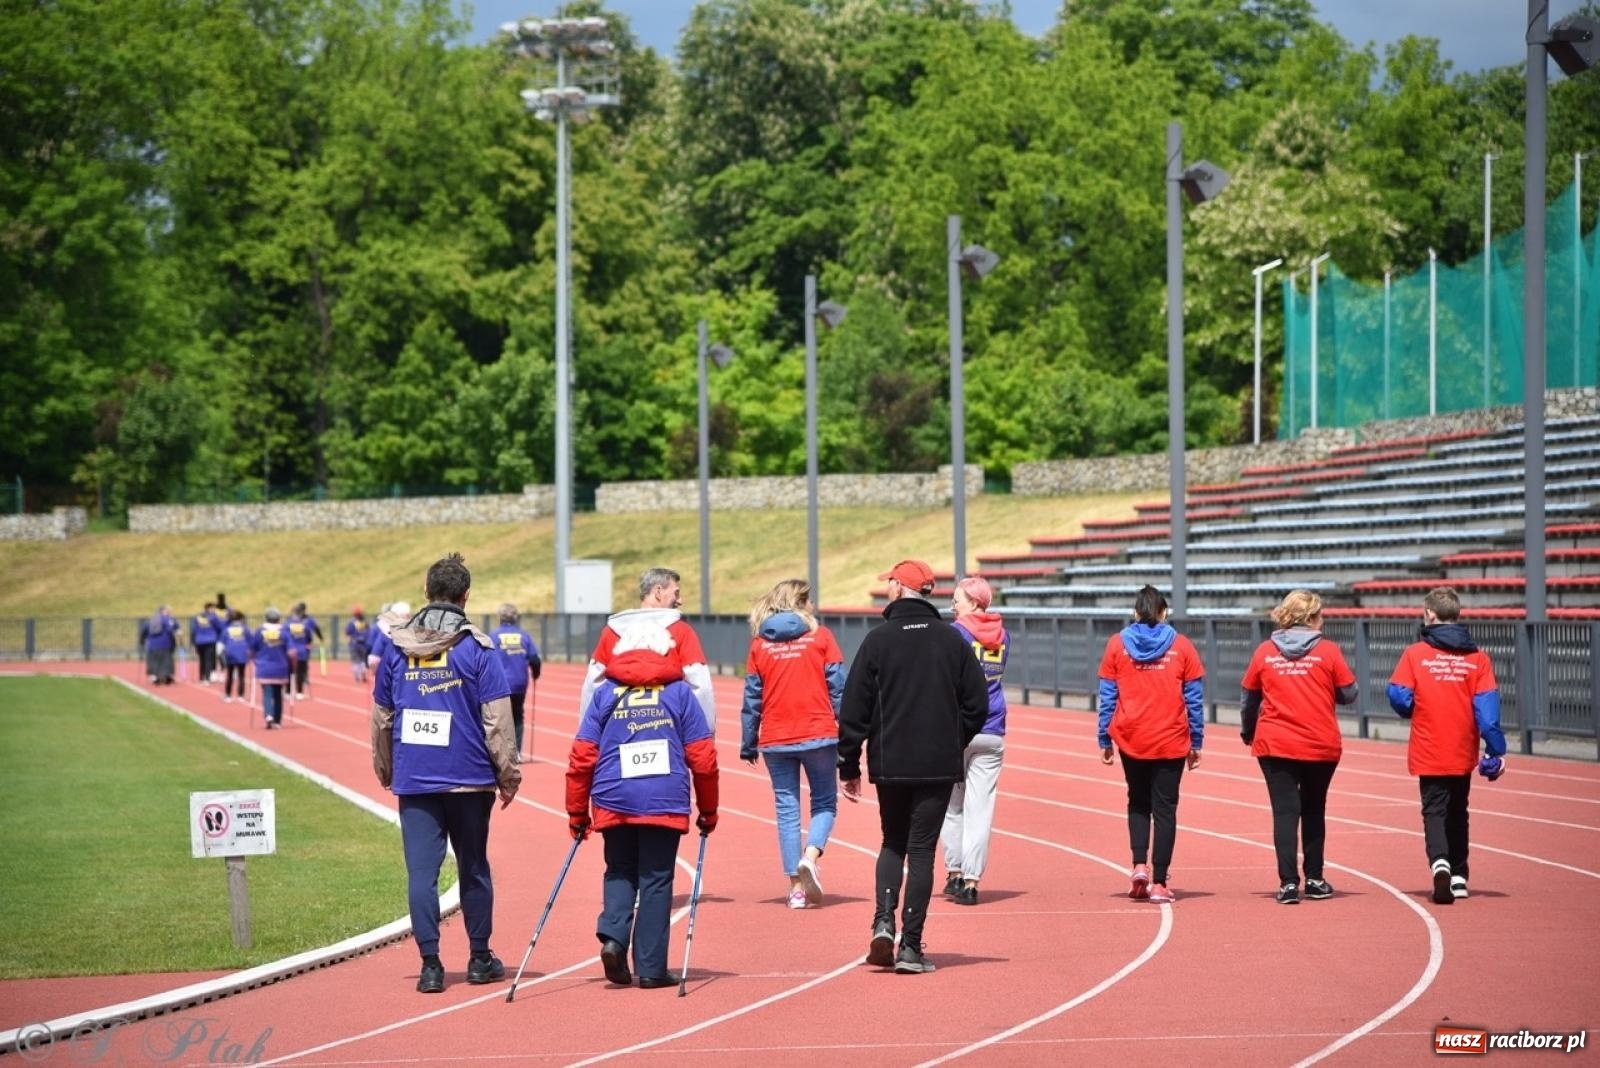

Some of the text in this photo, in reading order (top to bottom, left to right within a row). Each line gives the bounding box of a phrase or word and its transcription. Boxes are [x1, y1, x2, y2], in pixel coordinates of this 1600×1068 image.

[421, 670, 453, 680] SYSTEM
[631, 708, 665, 718] SYSTEM
[413, 721, 439, 734] 045
[632, 752, 657, 764] 057
